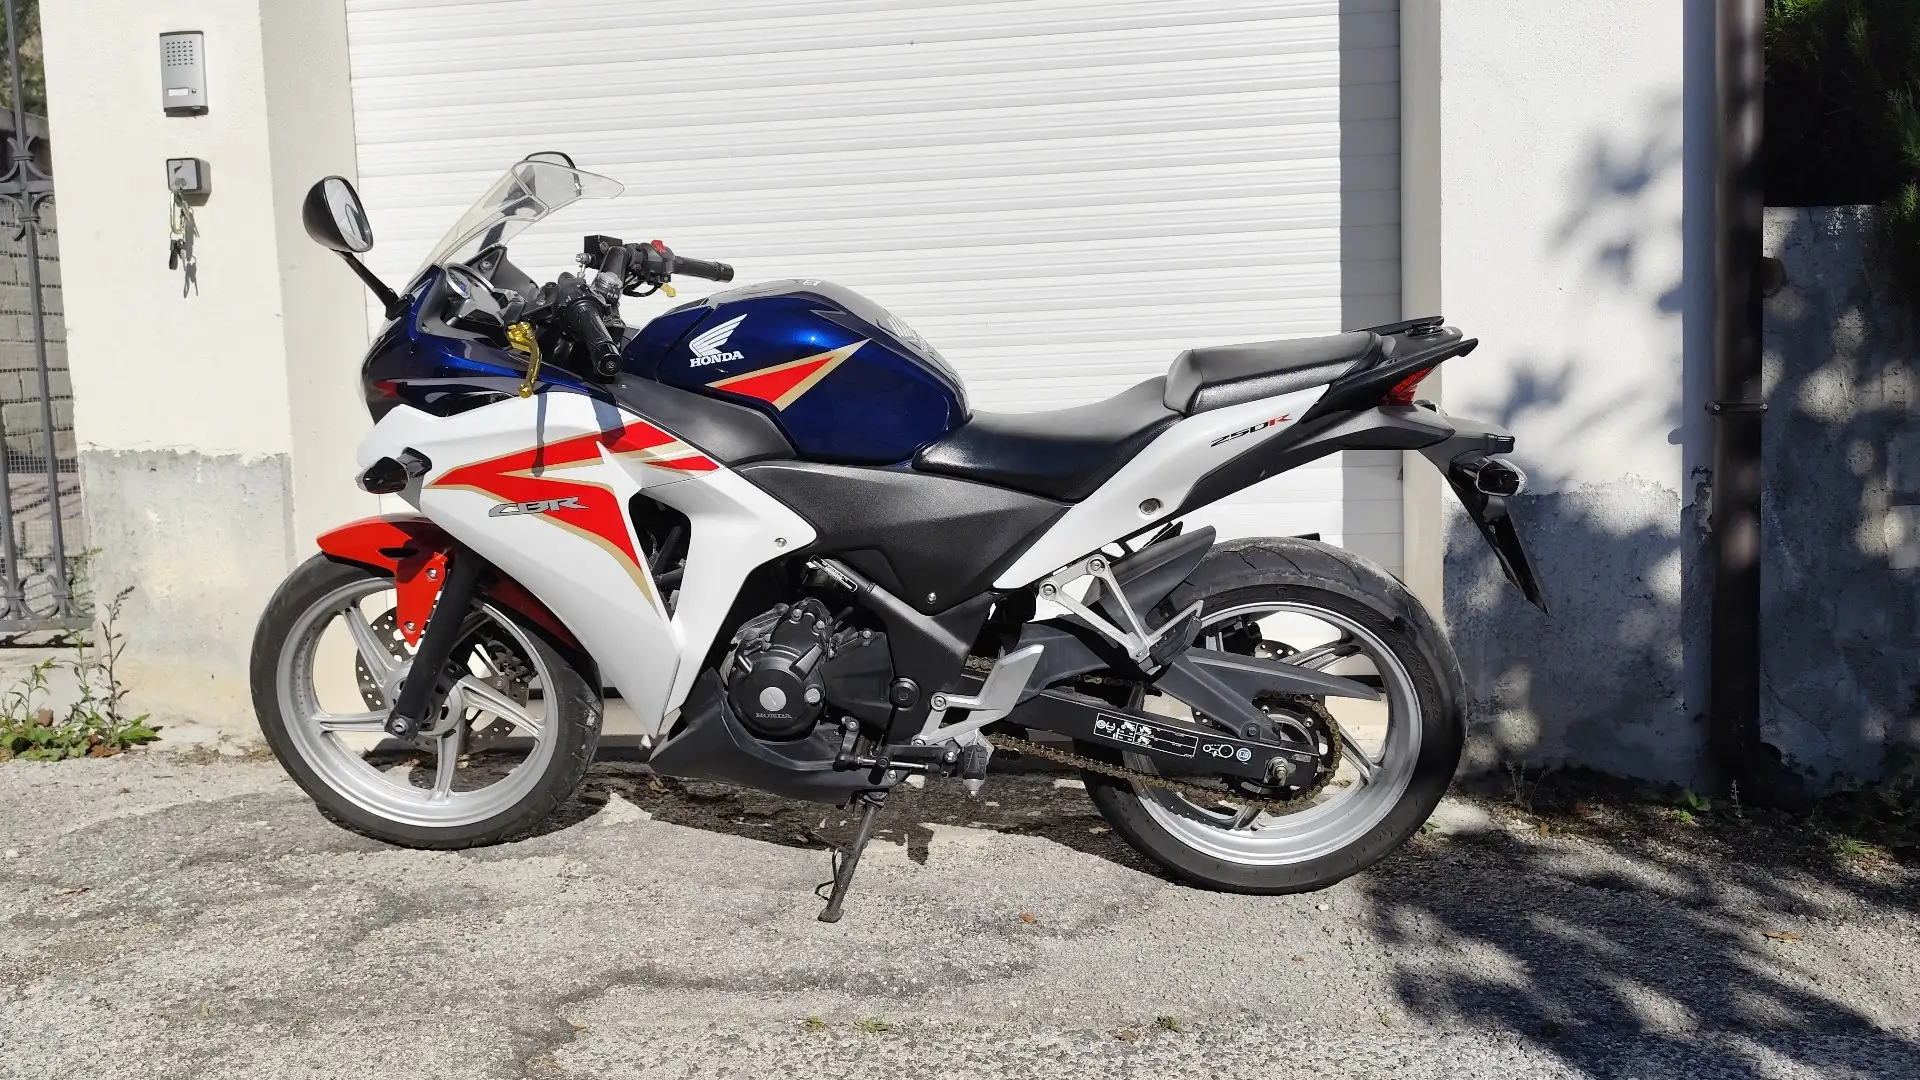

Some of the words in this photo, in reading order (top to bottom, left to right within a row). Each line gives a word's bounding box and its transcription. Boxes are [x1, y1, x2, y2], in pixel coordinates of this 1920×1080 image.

[690, 350, 745, 367] HONDA
[1210, 413, 1293, 448] 250R
[488, 496, 591, 517] CBR
